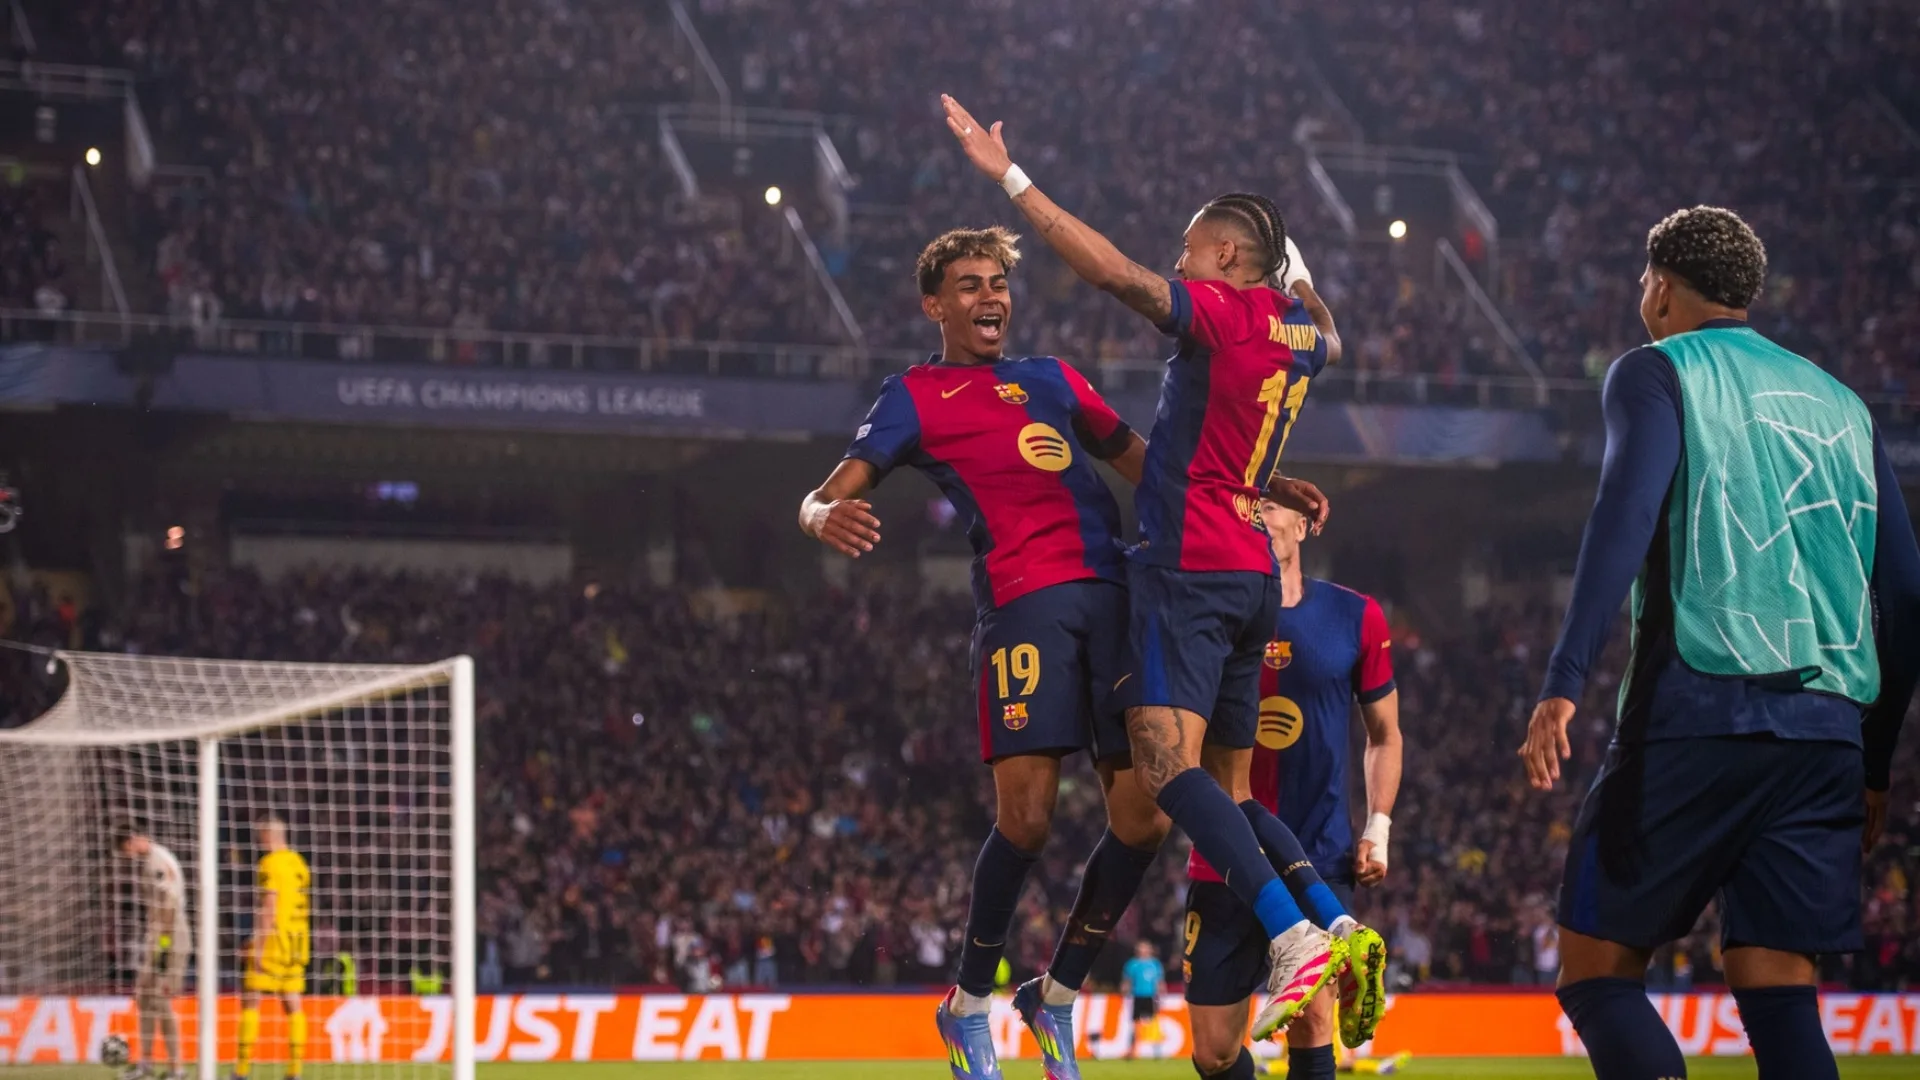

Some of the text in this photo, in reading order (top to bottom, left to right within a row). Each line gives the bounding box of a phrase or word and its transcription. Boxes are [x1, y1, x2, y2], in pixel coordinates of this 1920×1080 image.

[338, 377, 704, 418] UEFA CHAMPIONS LEAGUE
[1245, 369, 1310, 489] 11
[991, 643, 1040, 698] 19
[1185, 911, 1201, 956] 9
[411, 995, 791, 1061] JUST EAT
